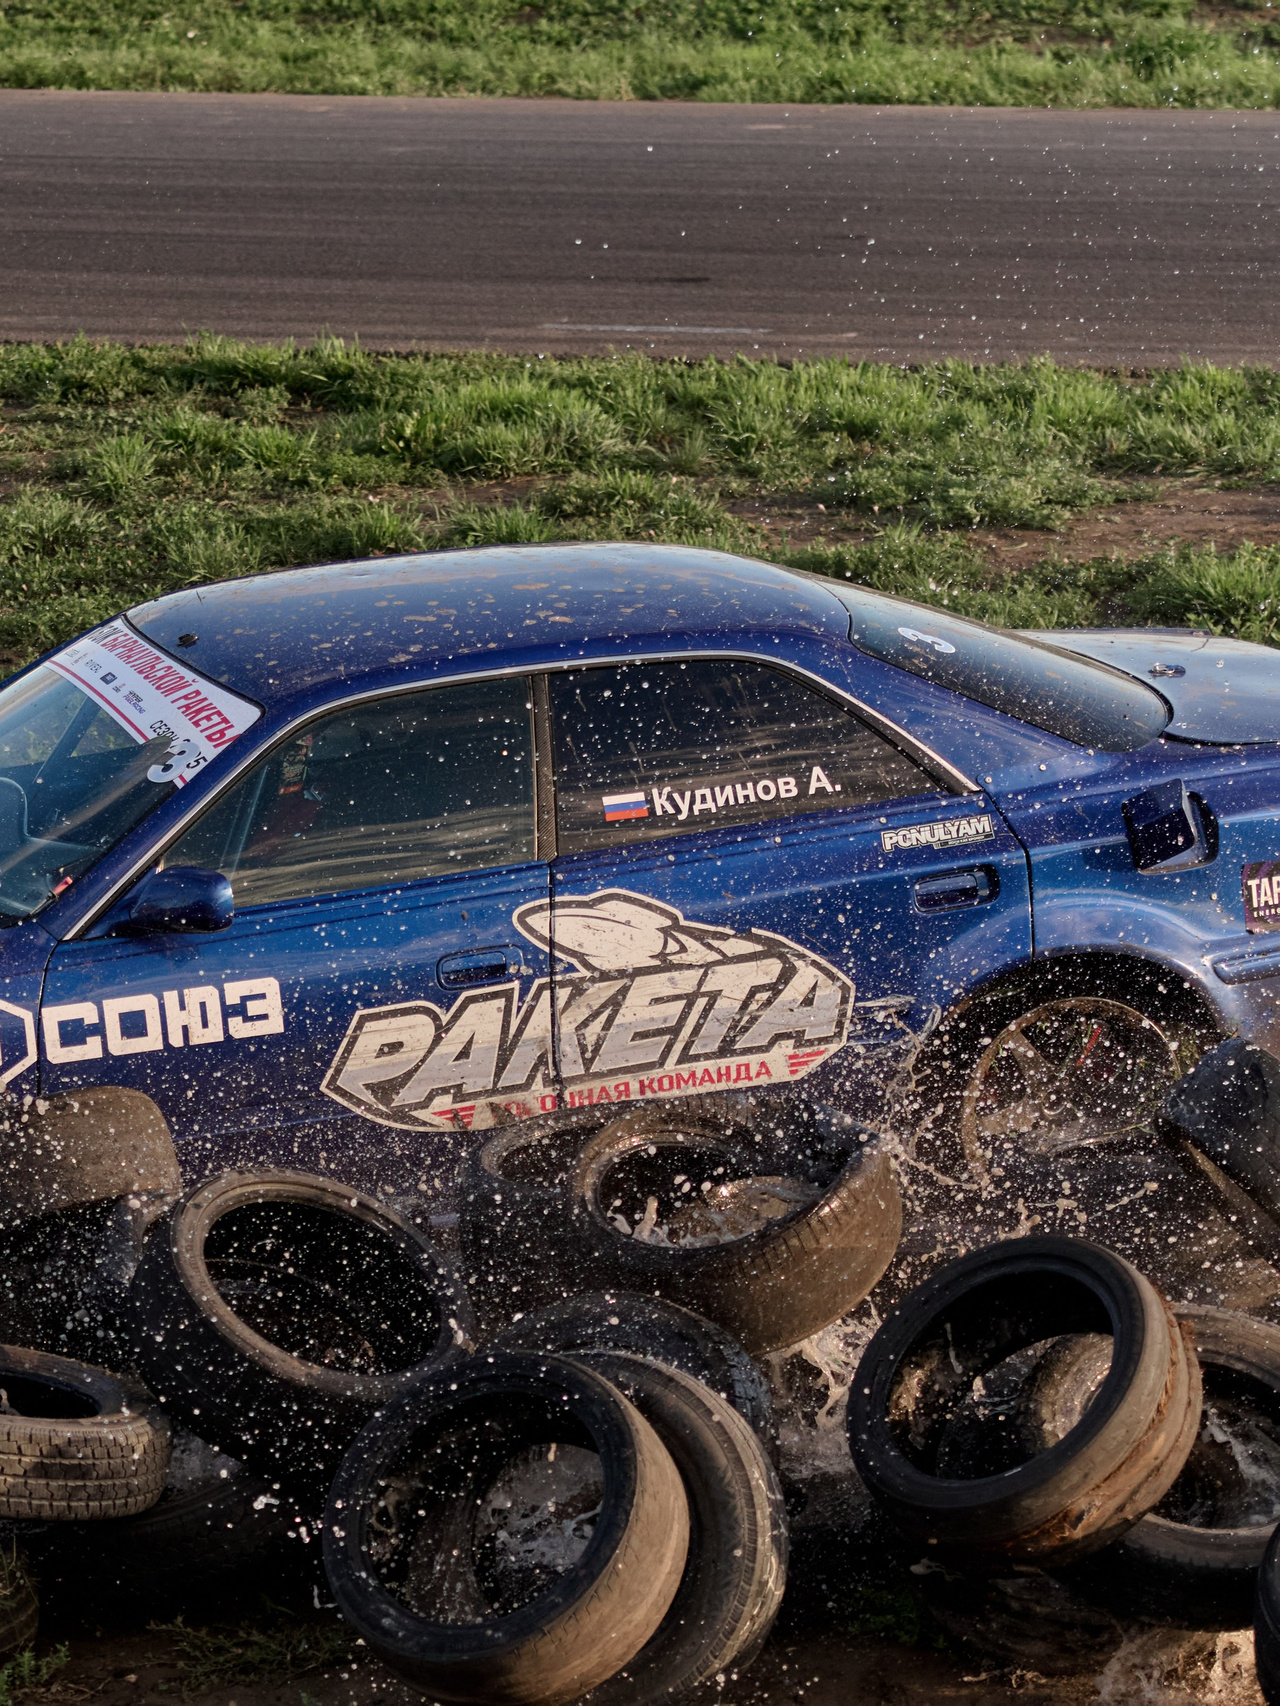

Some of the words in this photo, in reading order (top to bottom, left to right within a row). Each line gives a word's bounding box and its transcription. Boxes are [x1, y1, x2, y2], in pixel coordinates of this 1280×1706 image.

[100, 632, 200, 698] БАРНАУЛЬСКОЙ
[170, 689, 242, 749] РАКЕТЫ
[147, 742, 201, 783] 3
[651, 775, 797, 821] Кудинов
[808, 765, 842, 793] А.
[882, 815, 992, 852] PONULYAM
[41, 976, 285, 1065] СОЮЗ
[328, 953, 852, 1110] РАКЕТА
[638, 1060, 774, 1097] КОМАНДА
